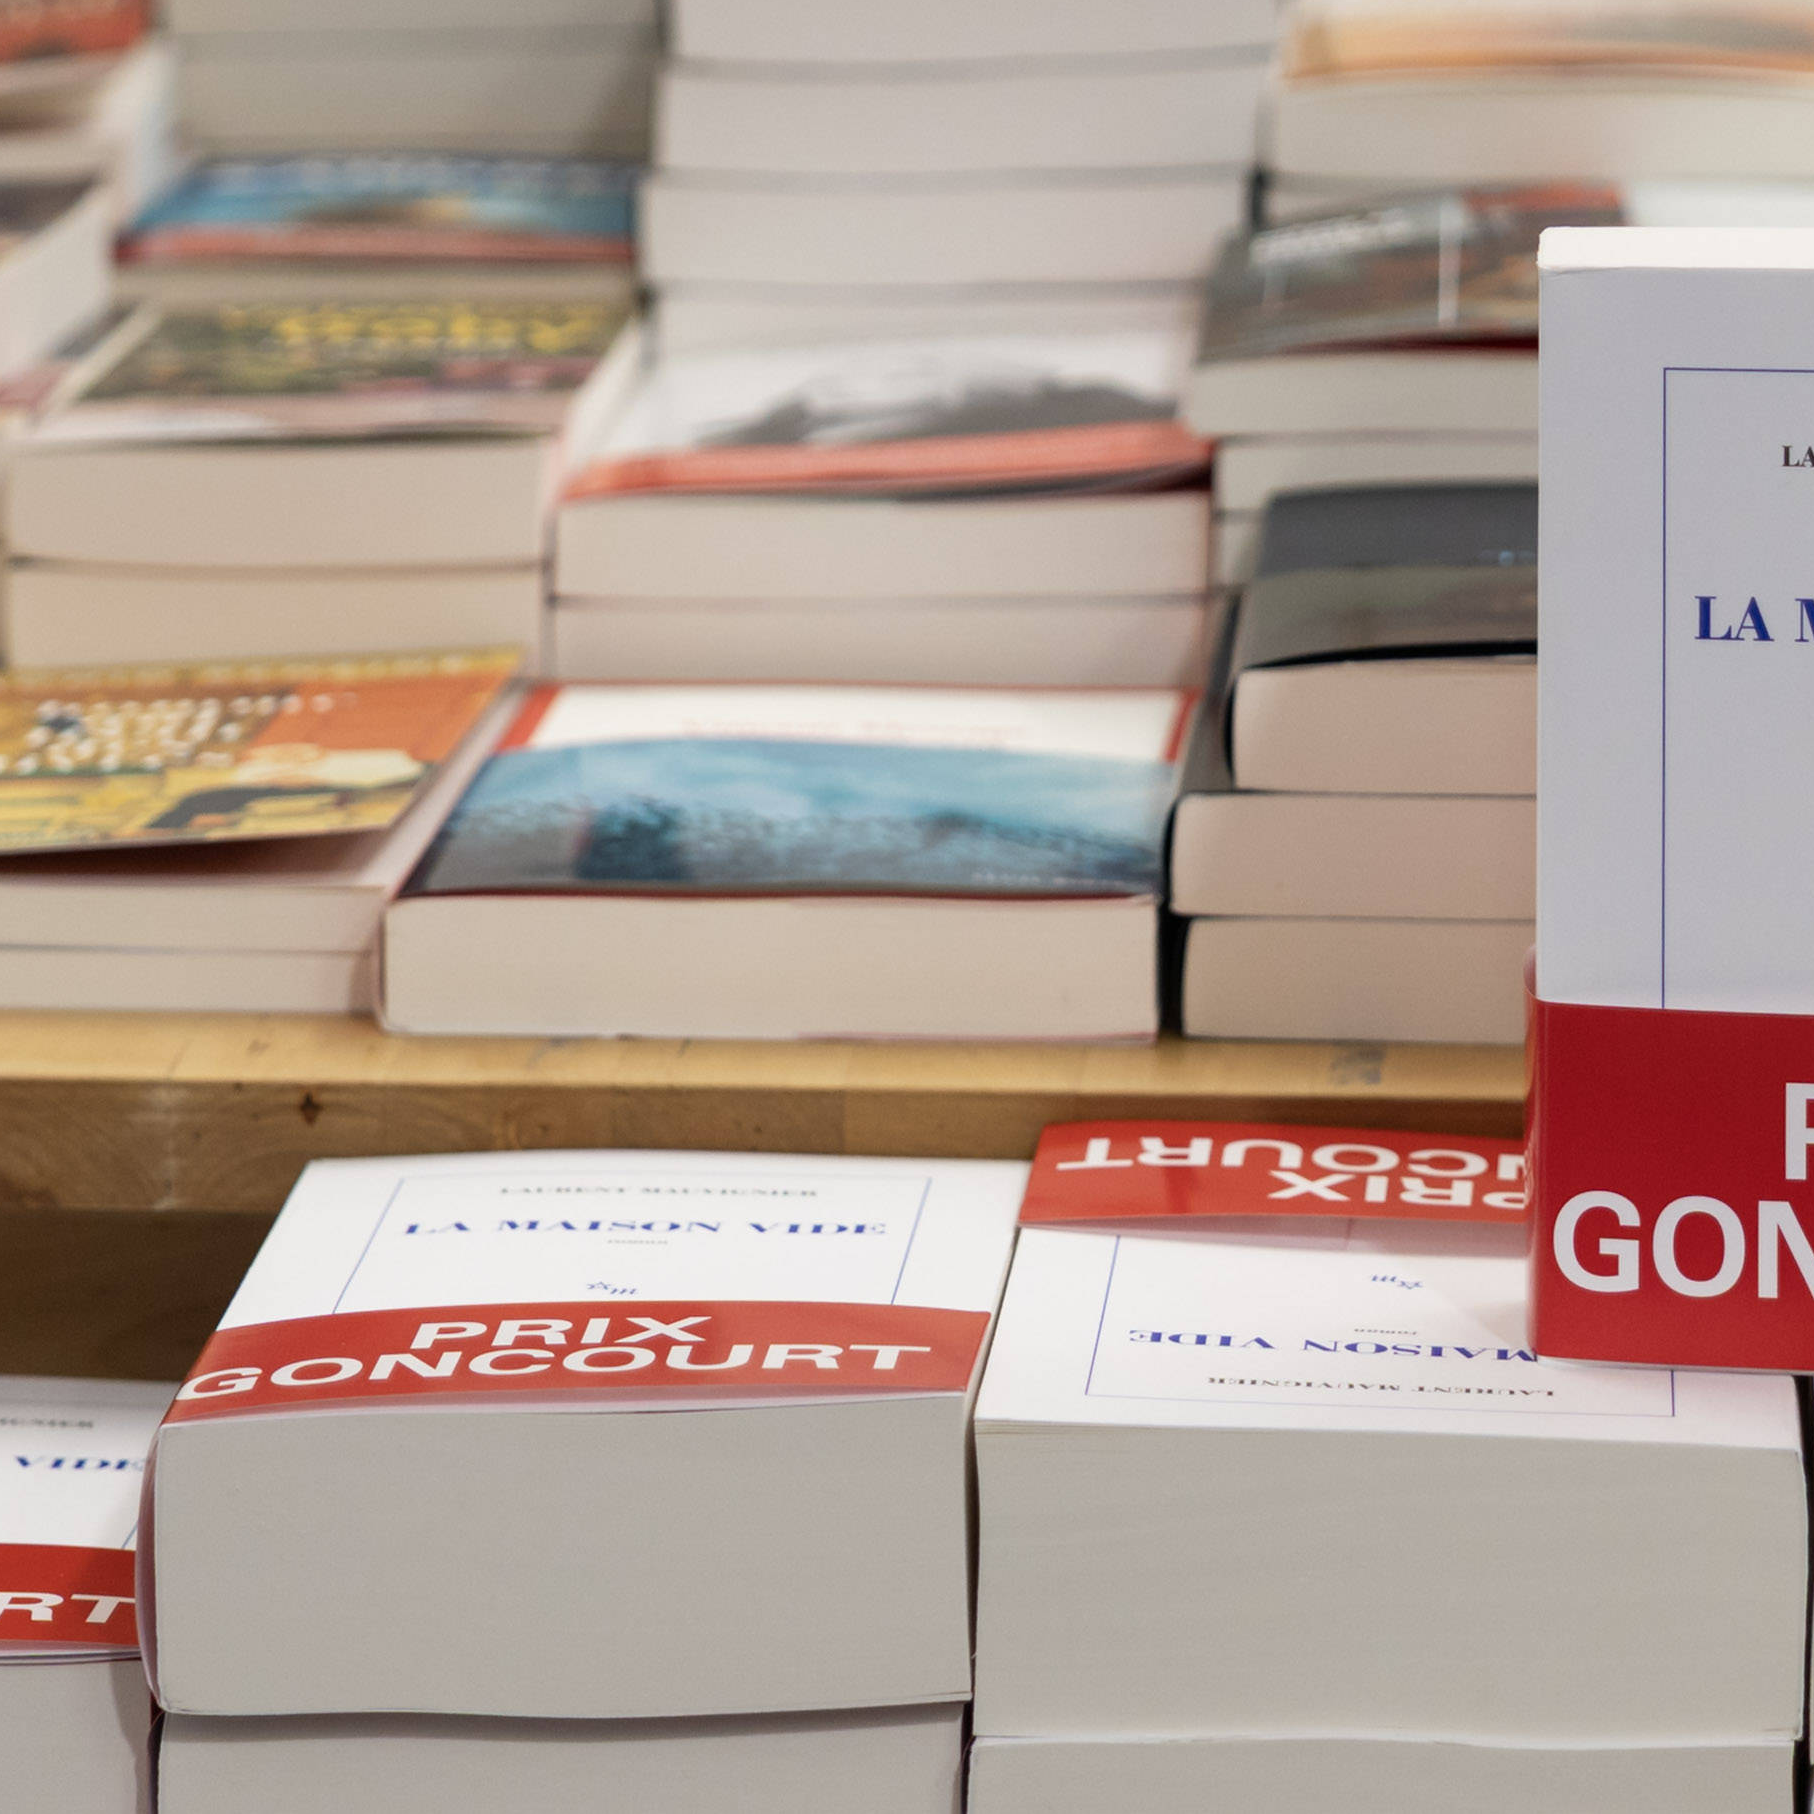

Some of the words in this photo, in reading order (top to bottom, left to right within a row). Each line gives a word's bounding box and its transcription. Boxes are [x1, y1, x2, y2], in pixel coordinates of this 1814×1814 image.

[1694, 595, 1774, 642] LA
[499, 1186, 628, 1196] LAURENT
[641, 1187, 818, 1198] MAUVIGNIER
[1268, 1170, 1526, 1209] PRIX
[405, 1221, 471, 1236] LA
[496, 1220, 722, 1235] MAISON
[749, 1222, 888, 1236] VIDE
[410, 1315, 713, 1351] PRIX
[1128, 1330, 1274, 1349] VIDE
[1303, 1339, 1539, 1363] MAISON
[176, 1344, 932, 1402] GONCOURT
[1208, 1377, 1400, 1392] MAUVIGNIER
[1408, 1385, 1555, 1397] LAURENT
